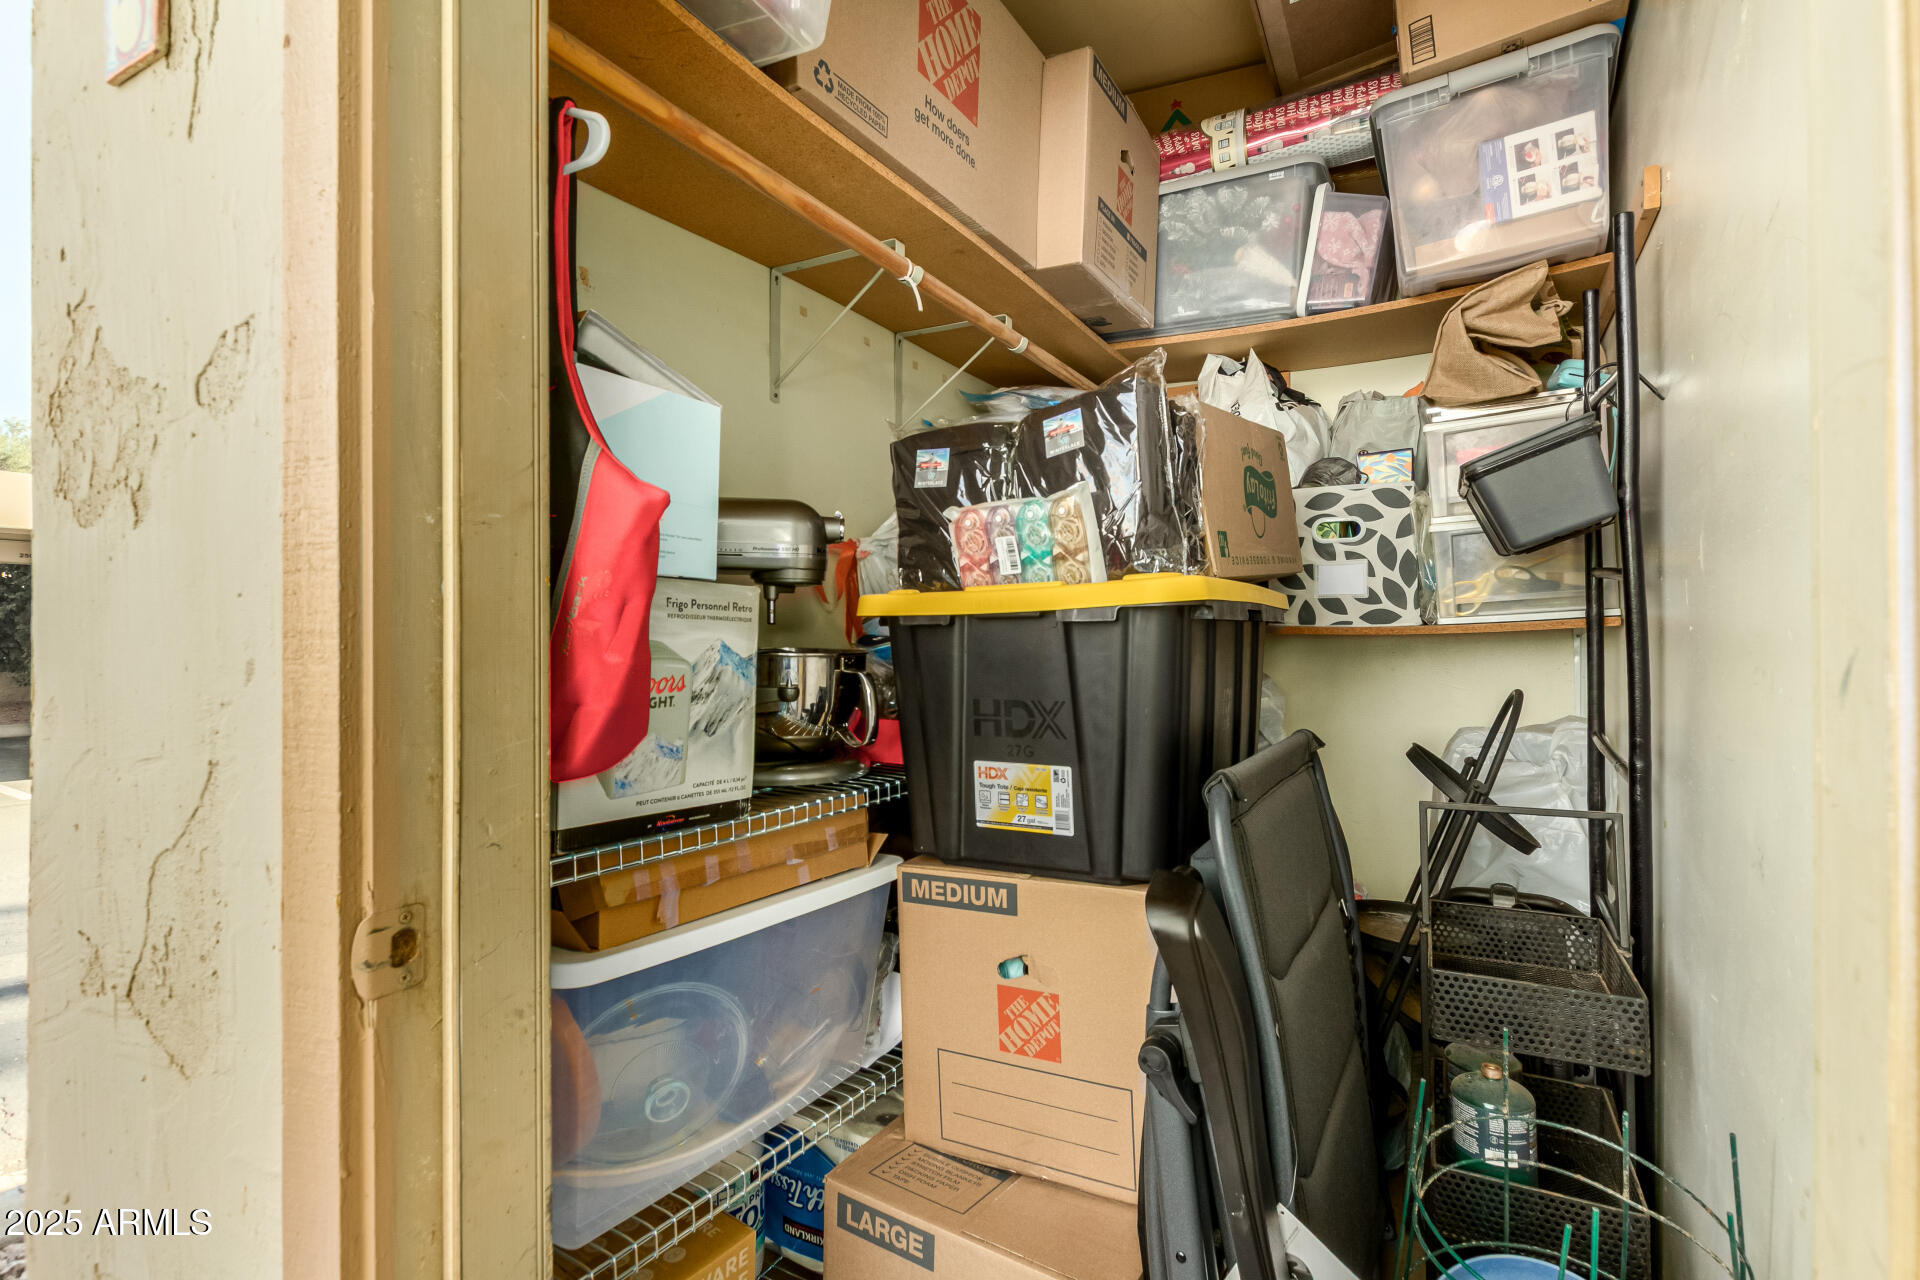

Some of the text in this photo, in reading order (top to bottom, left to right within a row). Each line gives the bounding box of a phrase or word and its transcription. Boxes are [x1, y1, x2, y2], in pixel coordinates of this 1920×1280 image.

[919, 7, 981, 83] HOME
[943, 53, 980, 100] DEPOT
[1096, 63, 1125, 117] MEDIUM
[838, 80, 854, 99] MADE
[856, 96, 872, 112] FROM
[838, 90, 886, 134] RECYCLED PAPER
[914, 108, 931, 129] get
[931, 122, 955, 150] more
[925, 95, 970, 147] How doers
[666, 597, 753, 613] Frigo Personnel Retro
[649, 674, 686, 694] oors
[649, 696, 675, 709] GHT
[973, 699, 1068, 740] HDX
[1008, 744, 1035, 759] 27G
[977, 766, 1008, 780] HDX
[979, 782, 996, 790] Tough
[650, 796, 676, 804] CONTENIR
[911, 878, 1008, 909] MEDIUM
[999, 992, 1060, 1054] HOME
[1003, 995, 1030, 1020] THE
[1023, 1020, 1061, 1057] DEPOT
[784, 1223, 824, 1246] KIRKLAND
[846, 1203, 924, 1260] LARGE
